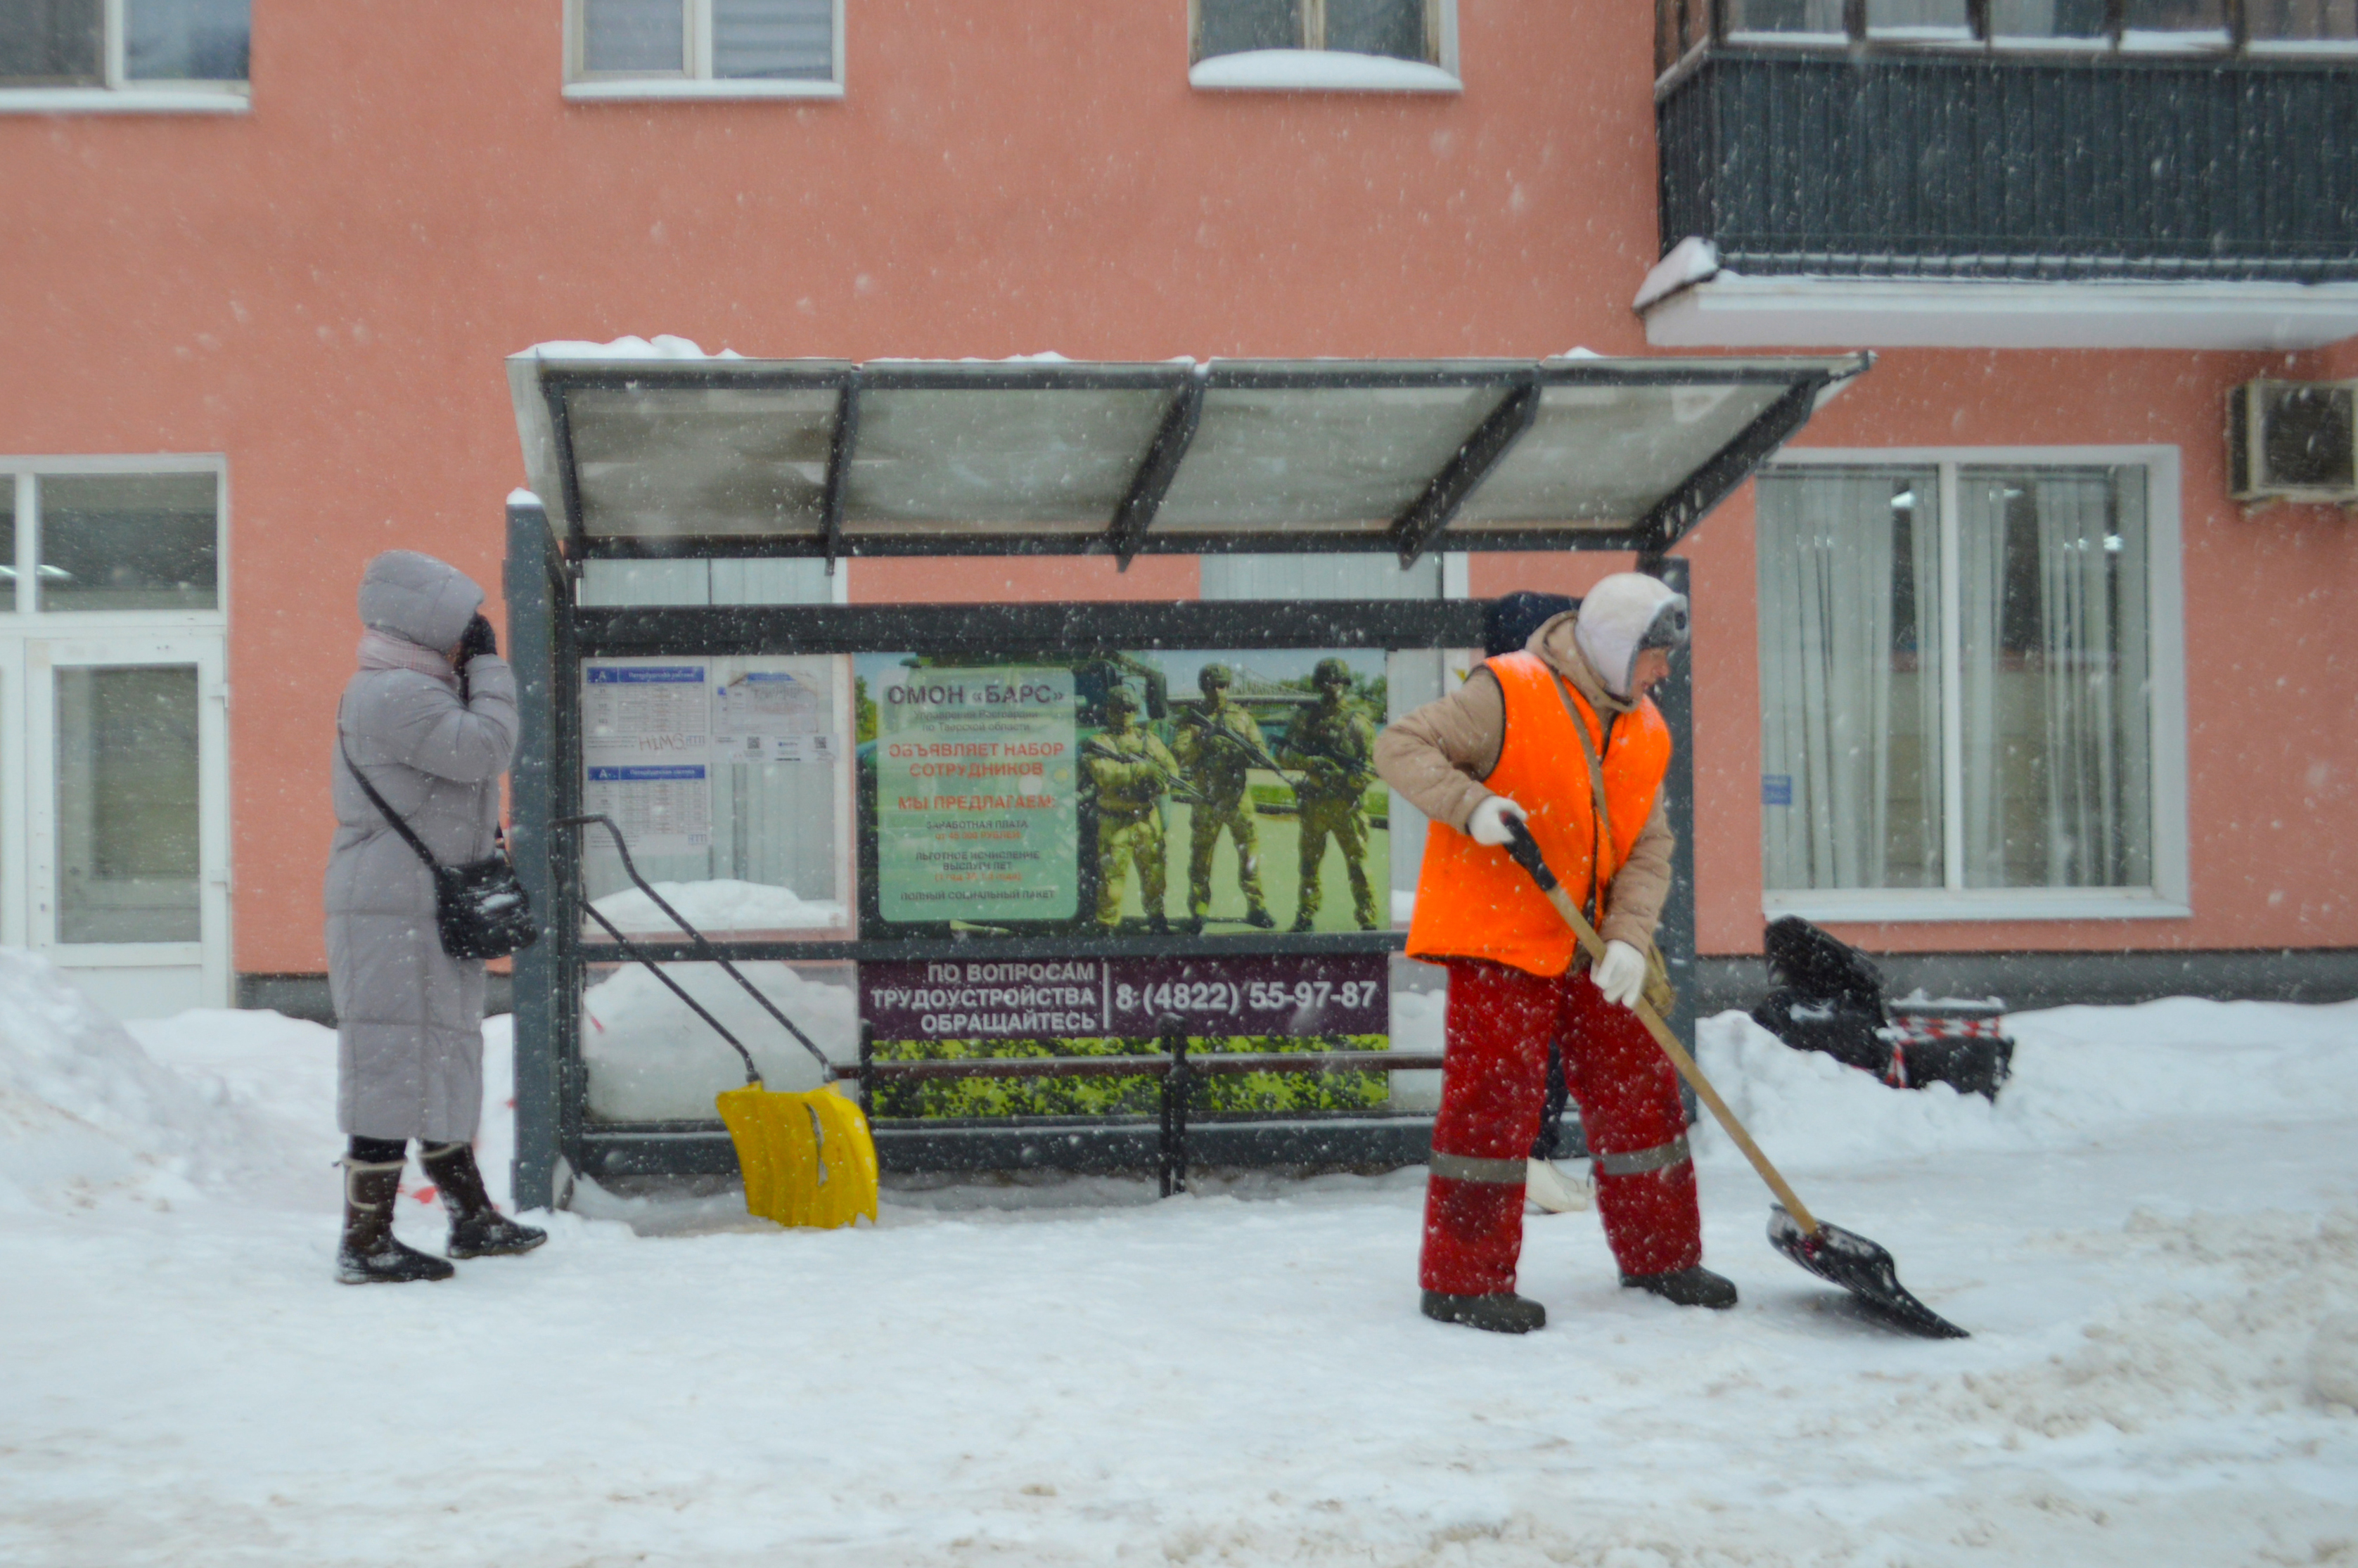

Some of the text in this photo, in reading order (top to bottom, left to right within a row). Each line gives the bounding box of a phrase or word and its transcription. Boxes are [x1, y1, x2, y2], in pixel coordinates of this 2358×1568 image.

[888, 684, 1063, 704] ОМОН «БАРС»
[923, 723, 935, 733] по
[889, 742, 1065, 758] ОБЪЯВЛЯЕТ НАБОР
[909, 761, 1044, 778] СОТРУДНИКОВ
[898, 796, 929, 811] МЫ
[995, 820, 1029, 829] ПЛАТА
[901, 889, 1056, 901] ПОЛНЫЙ СОЦИАЛЬНЫЙ ПАКЕТ
[928, 962, 1094, 982] ПО ВОПРОСАМ
[871, 984, 1096, 1010] ТРУДОУСТРОЙСТВА
[1115, 980, 1377, 1017] 8 (4822) 55-97-87
[921, 1008, 1096, 1034] ОБРАЩАЙТЕСЬ
